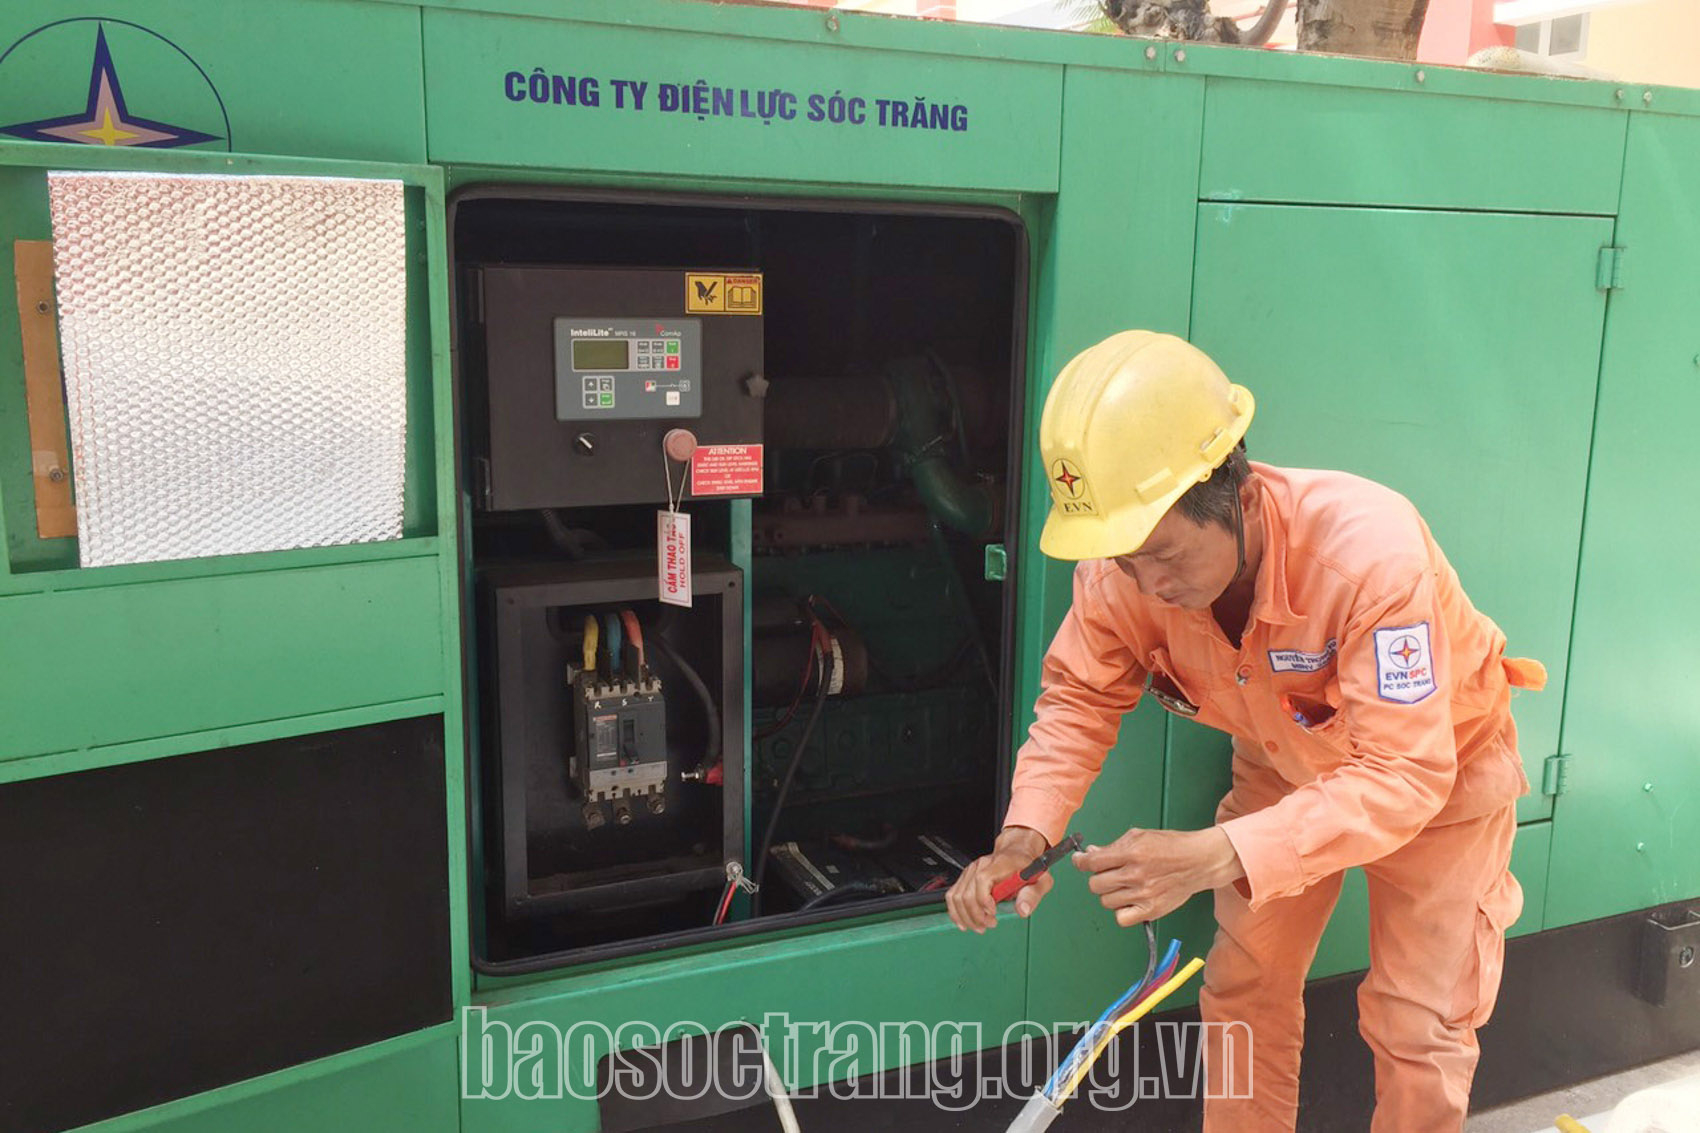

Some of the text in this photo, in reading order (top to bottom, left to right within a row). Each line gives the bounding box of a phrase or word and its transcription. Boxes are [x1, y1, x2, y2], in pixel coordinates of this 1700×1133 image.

[504, 67, 968, 131] CÔNG TY ĐIỆN LỰC SÓC TRĂNG
[708, 447, 748, 455] ATTENTION
[1063, 501, 1093, 512] EVN
[666, 544, 677, 571] THAO
[678, 532, 686, 588] HOLD OFF
[622, 698, 628, 707] S
